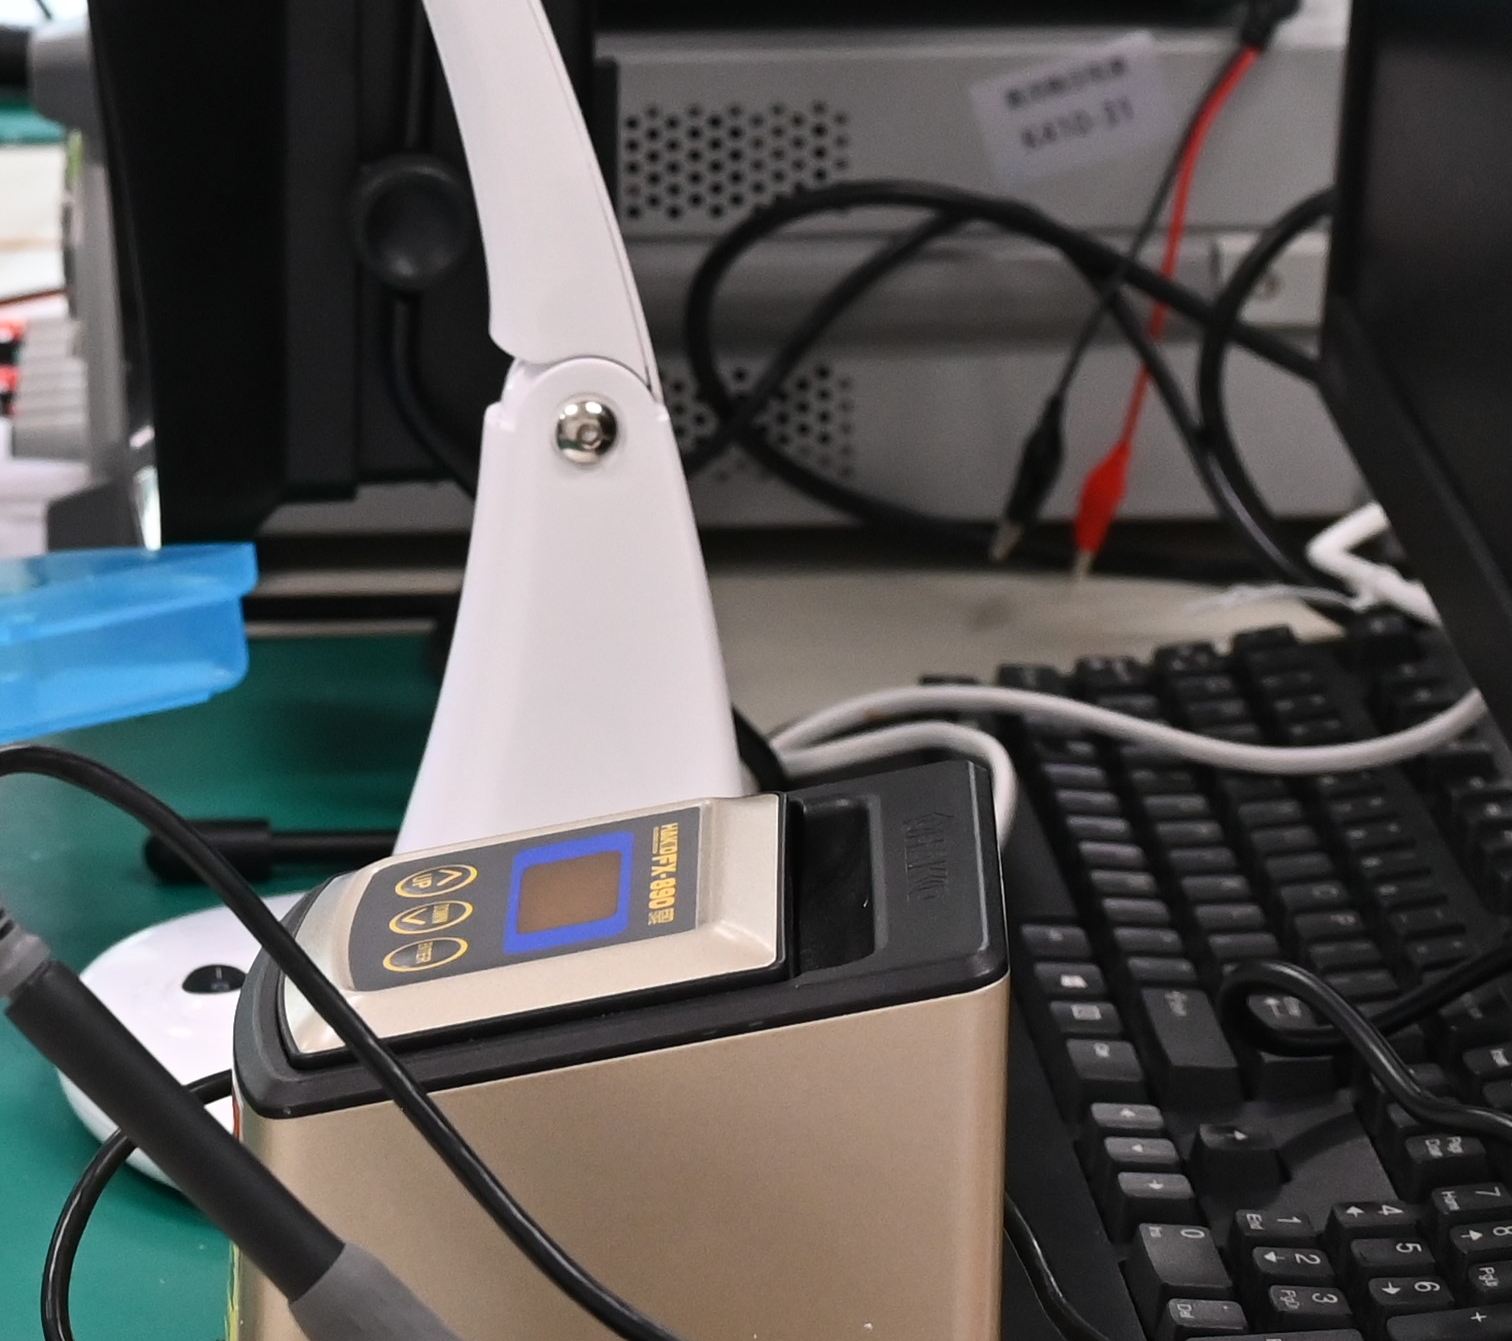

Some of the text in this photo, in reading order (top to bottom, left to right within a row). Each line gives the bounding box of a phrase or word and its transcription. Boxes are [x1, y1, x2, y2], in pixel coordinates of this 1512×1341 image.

[411, 873, 433, 889] UP
[1475, 1186, 1502, 1198] 7
[1377, 1203, 1404, 1216] 4
[1276, 1216, 1303, 1225] 1
[1179, 1227, 1206, 1240] 0
[1395, 1242, 1423, 1254] 5
[1294, 1252, 1322, 1265] 2
[1413, 1280, 1441, 1293] 6
[1311, 1292, 1339, 1304] 3
